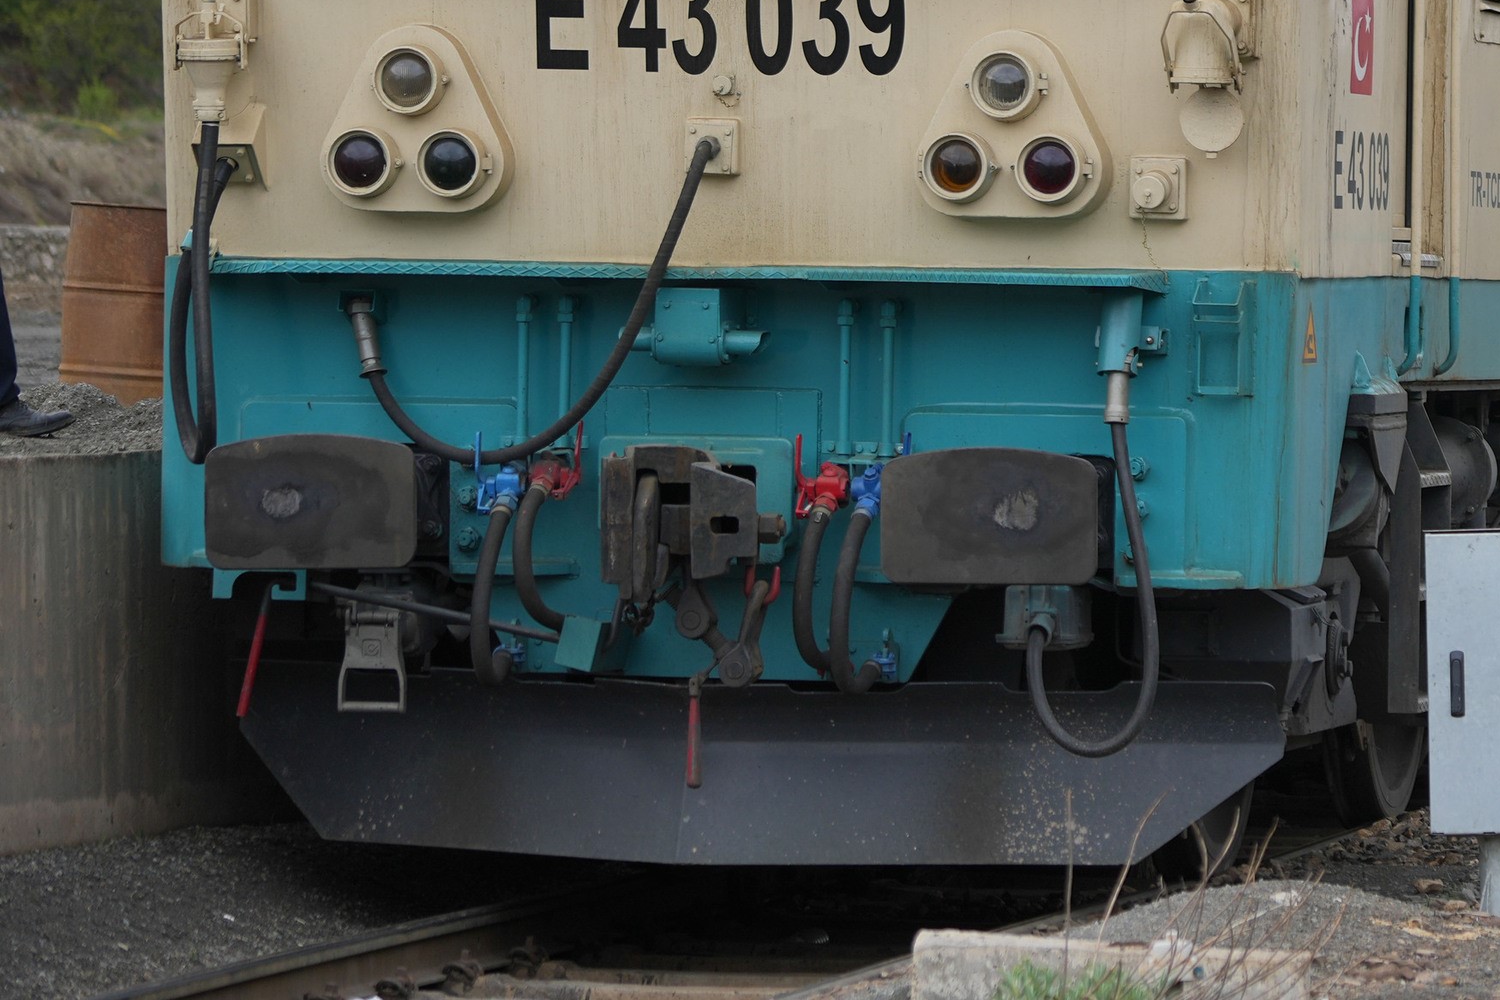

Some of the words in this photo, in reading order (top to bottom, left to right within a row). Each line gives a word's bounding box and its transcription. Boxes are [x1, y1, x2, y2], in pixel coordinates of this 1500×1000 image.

[1334, 131, 1344, 210] E
[1347, 131, 1365, 211] 43
[1368, 132, 1390, 211] 039
